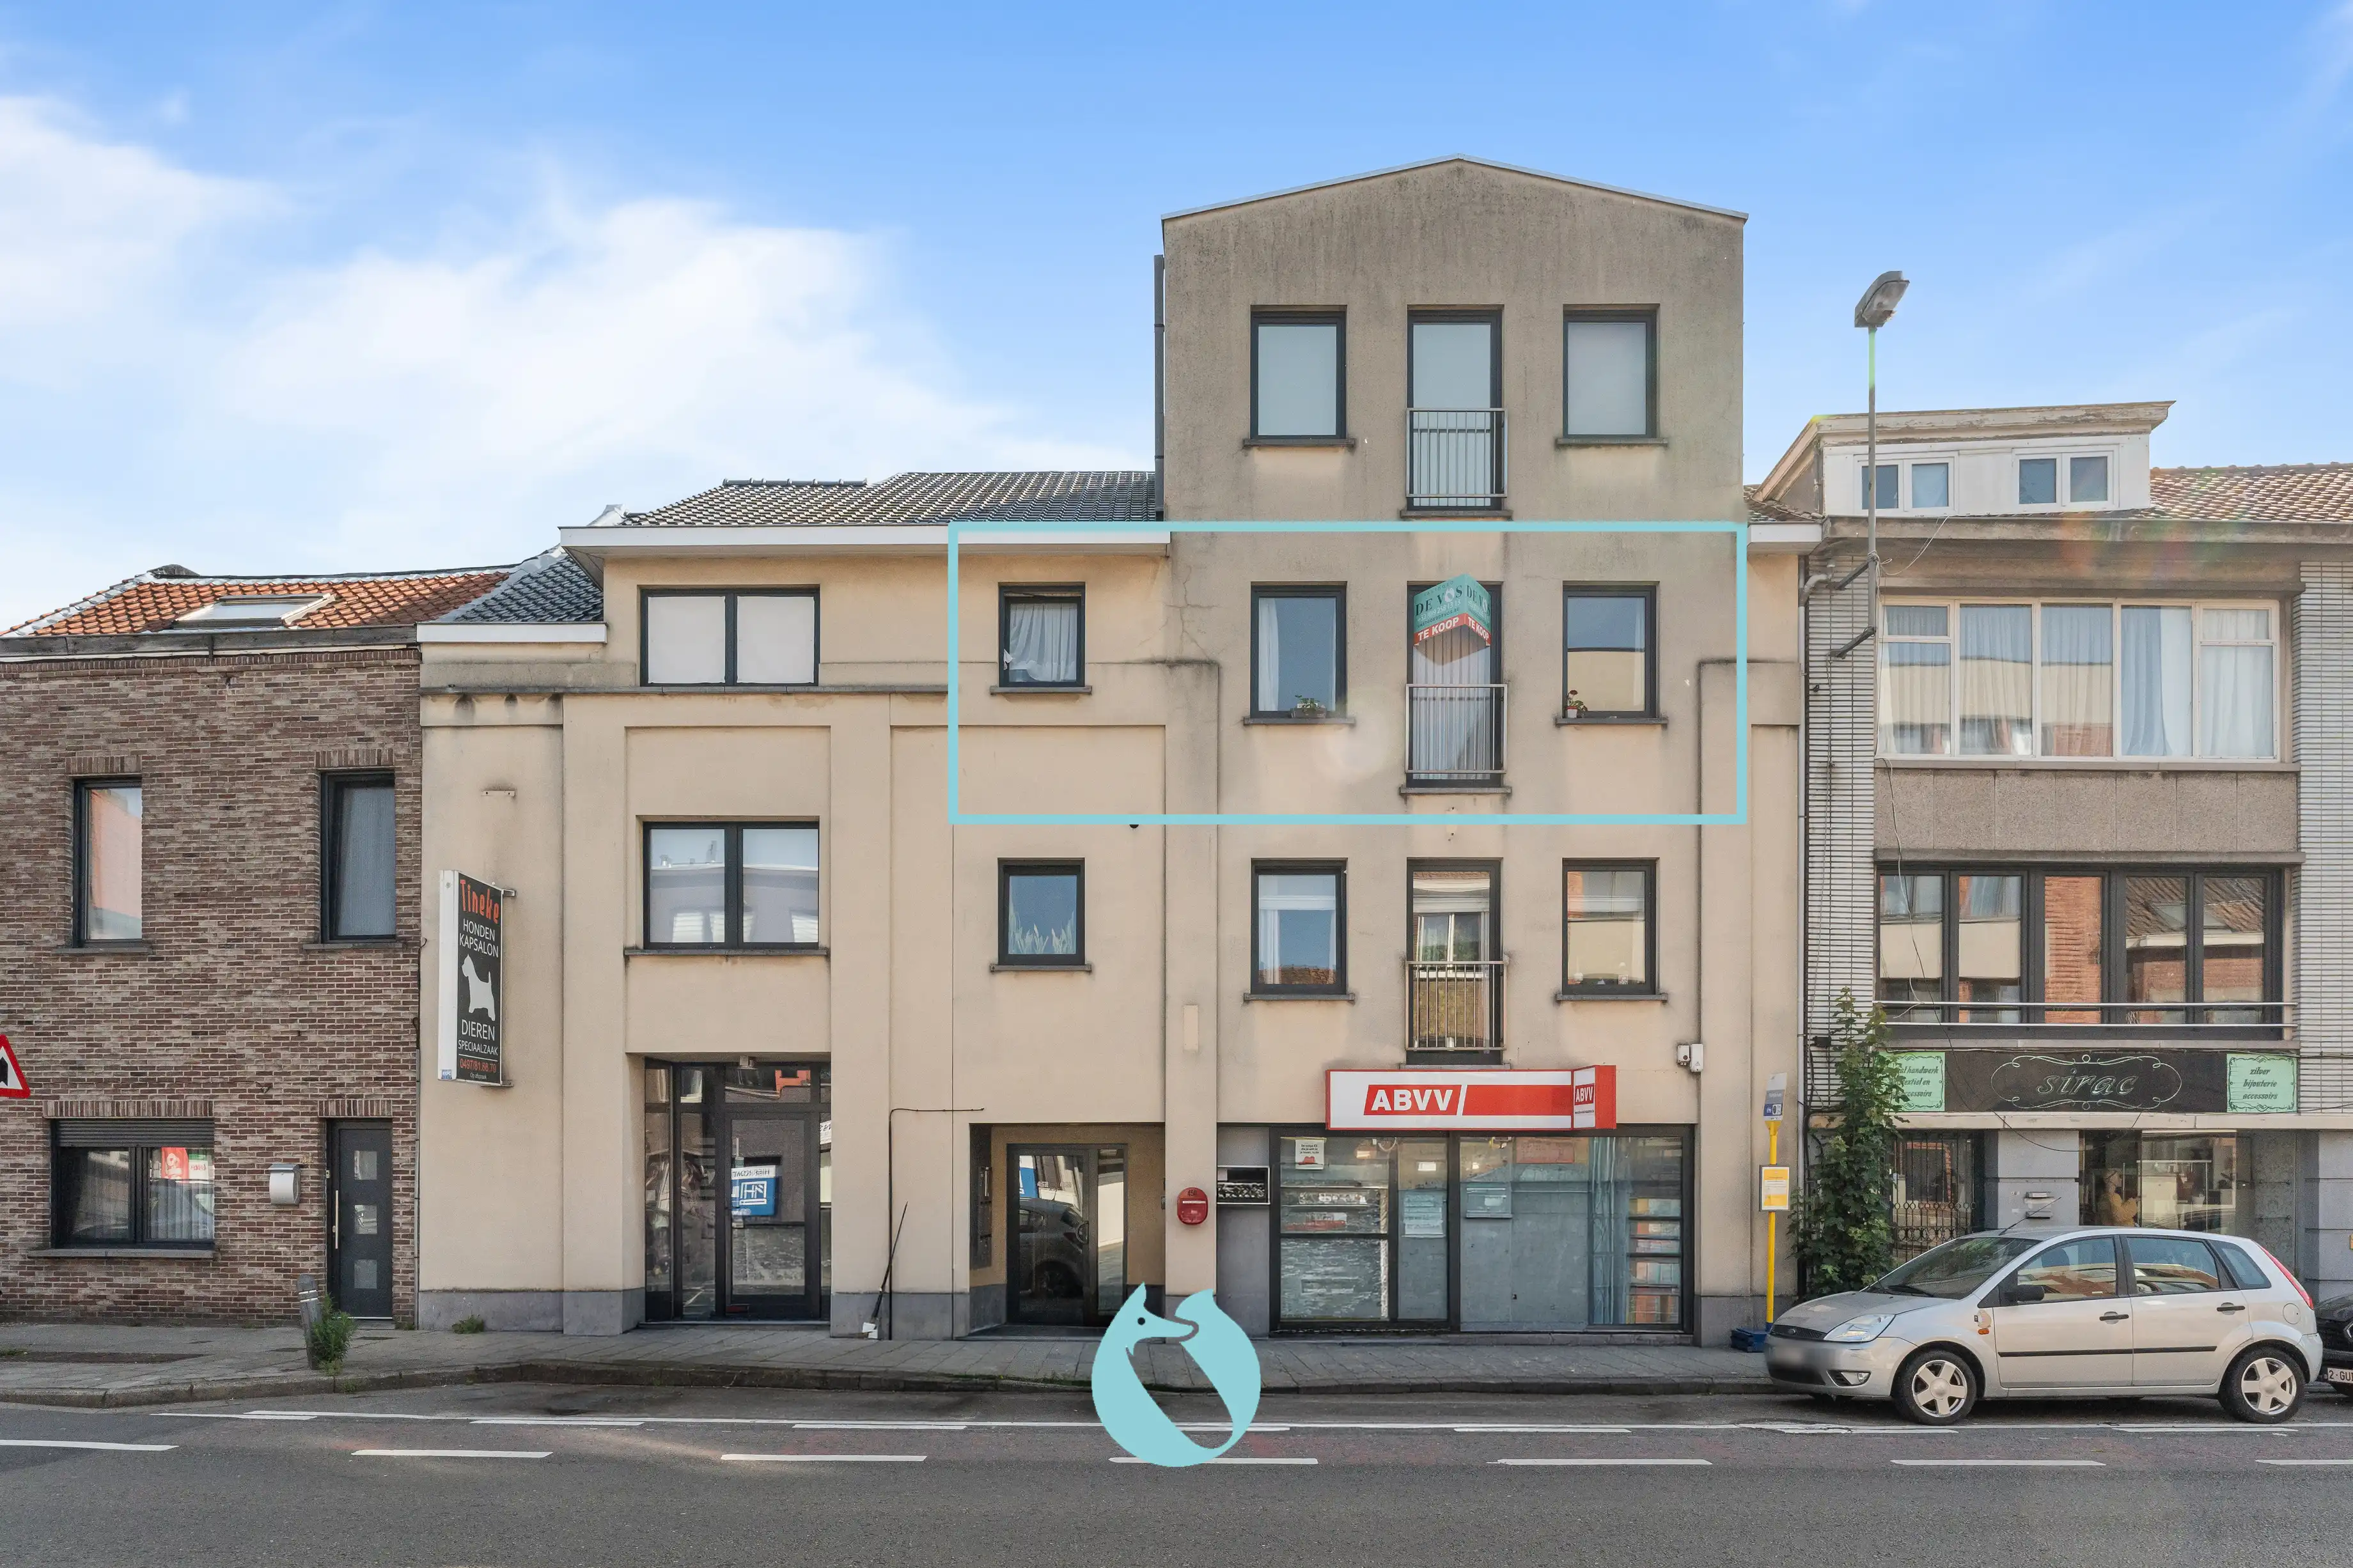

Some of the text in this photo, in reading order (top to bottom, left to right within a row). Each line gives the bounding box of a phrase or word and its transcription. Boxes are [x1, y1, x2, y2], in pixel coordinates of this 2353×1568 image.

[1467, 585, 1477, 603] DE
[1415, 598, 1433, 617] DE
[1418, 628, 1430, 641] TE
[1432, 617, 1459, 635] KOOP
[1468, 616, 1475, 630] TE
[1476, 623, 1489, 640] KOOP
[460, 879, 499, 924] Tineke
[463, 918, 496, 942] HONDEN
[459, 933, 499, 958] KAPSALON
[462, 1019, 495, 1041] DIEREN
[458, 1039, 498, 1056] SPECIAALZAAK
[1907, 1066, 1939, 1074] handwerk
[2250, 1067, 2271, 1075] zilver
[2036, 1067, 2139, 1096] sirac
[2242, 1078, 2277, 1089] bijouterie
[1371, 1089, 1453, 1111] ABVV
[1575, 1087, 1593, 1103] ABVV
[2329, 1370, 2353, 1381] 2-GU
